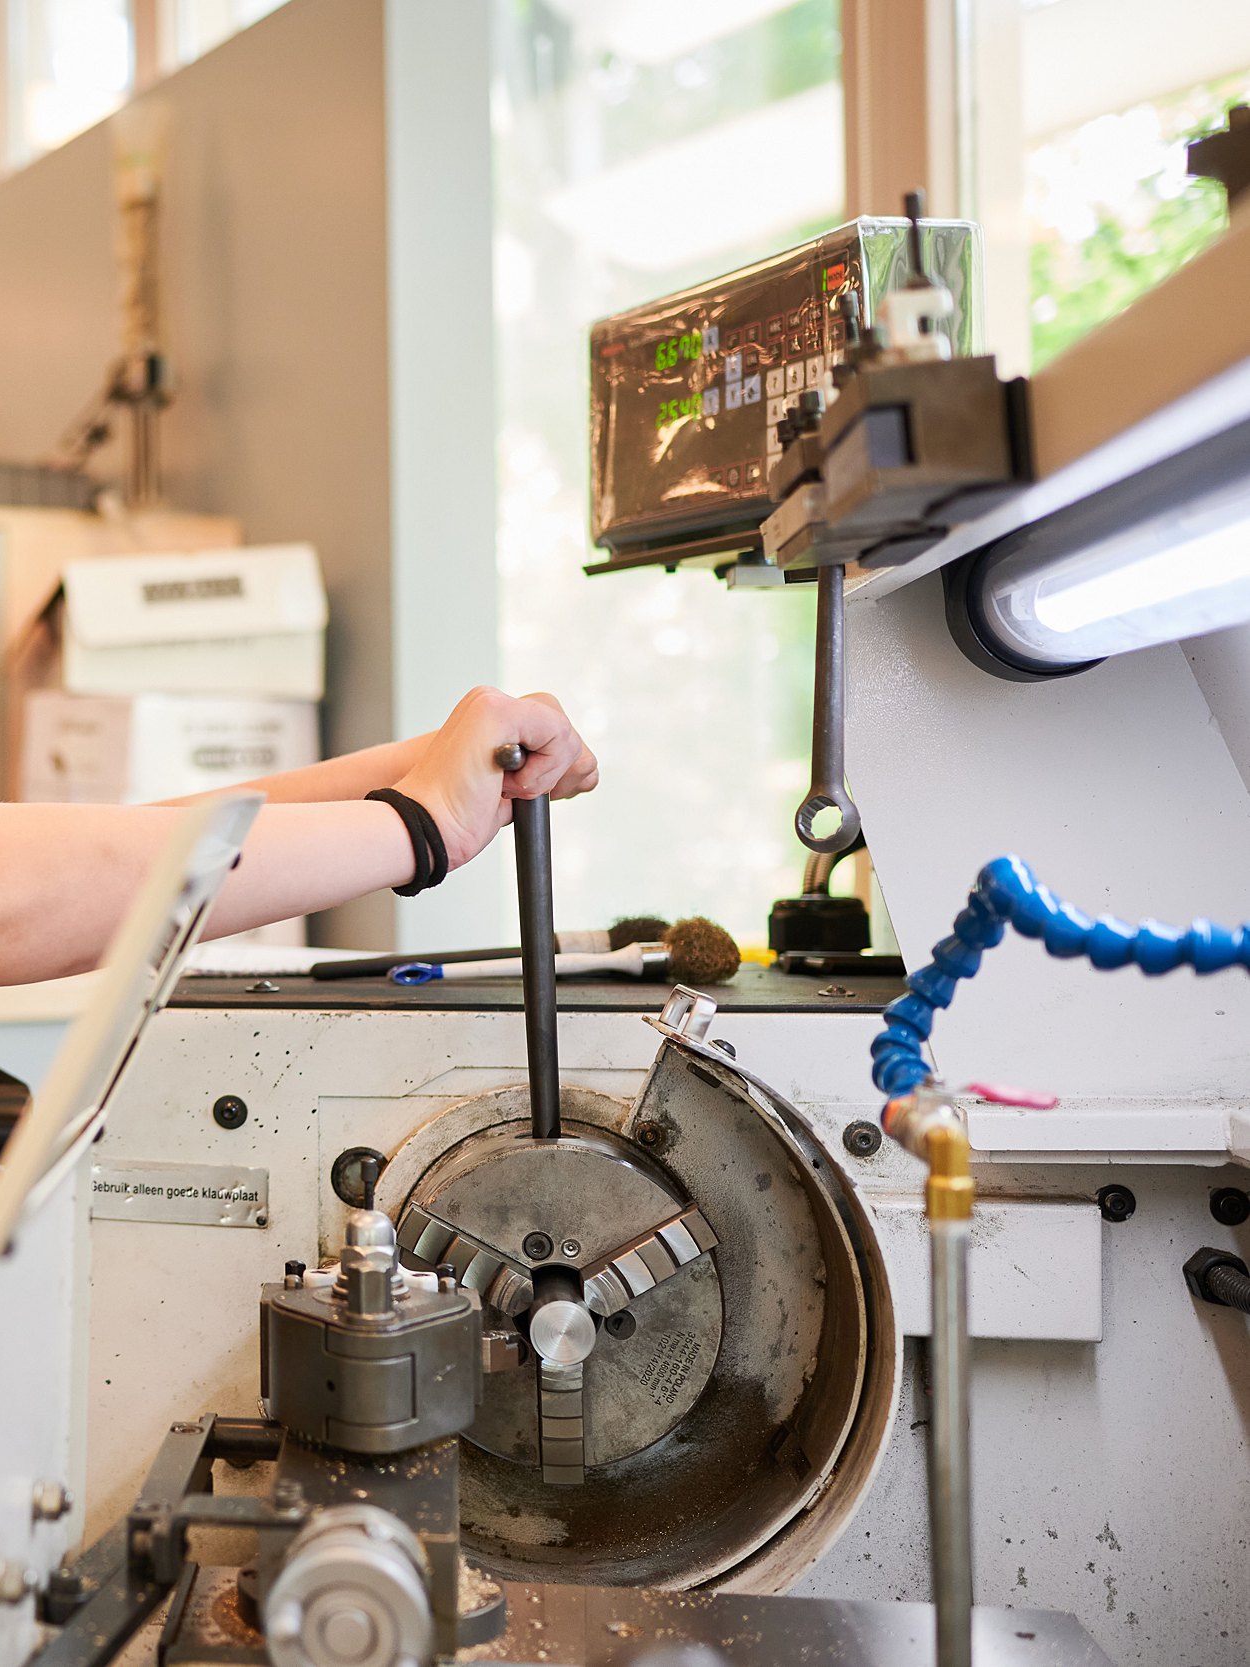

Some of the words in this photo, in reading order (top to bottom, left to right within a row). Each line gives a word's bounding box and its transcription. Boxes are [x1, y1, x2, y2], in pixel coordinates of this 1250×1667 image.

[133, 1183, 164, 1196] alleen
[166, 1186, 199, 1202] goede
[202, 1186, 259, 1203] klauwplaat
[665, 1331, 696, 1384] 3544-160-4
[669, 1339, 680, 1355] max
[685, 1342, 701, 1366] MADE
[639, 1333, 671, 1386] 102114/2020
[680, 1364, 691, 1375] IN
[666, 1374, 686, 1404] POLAND
